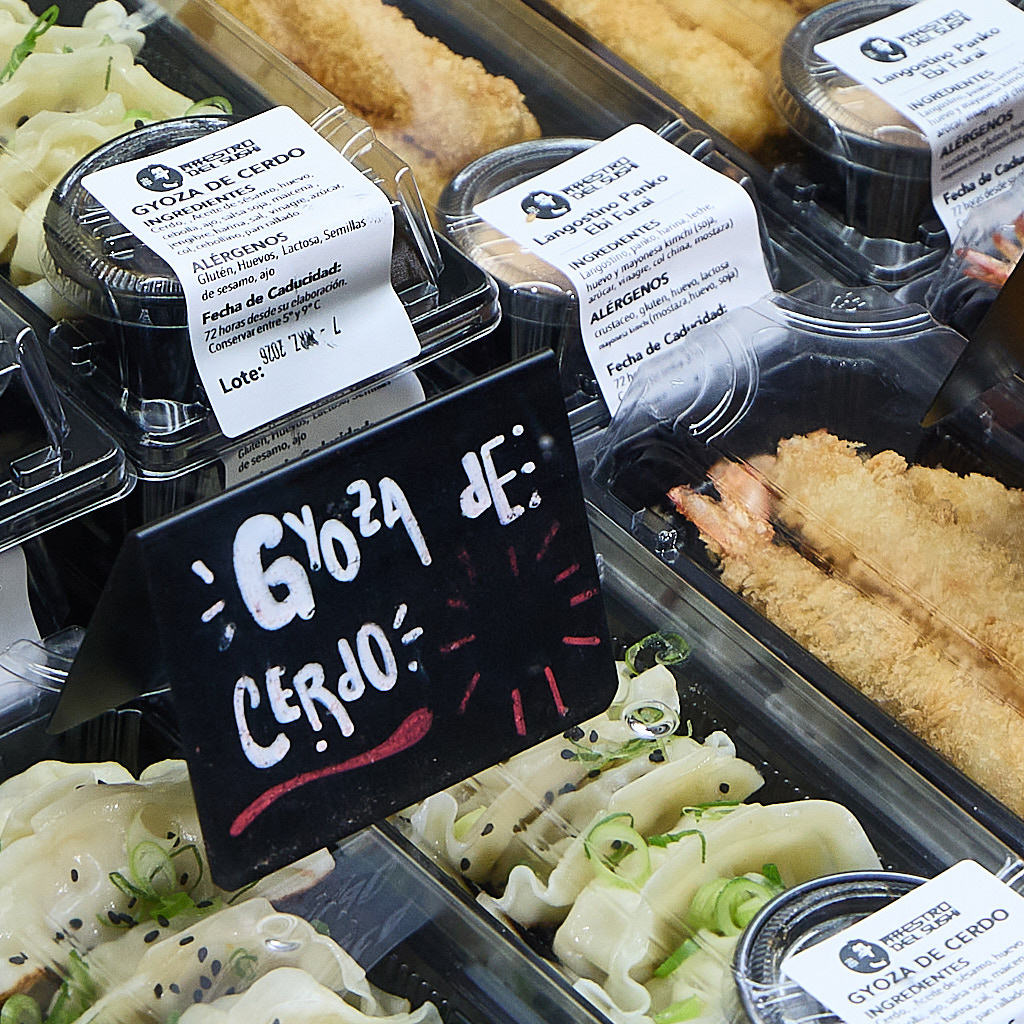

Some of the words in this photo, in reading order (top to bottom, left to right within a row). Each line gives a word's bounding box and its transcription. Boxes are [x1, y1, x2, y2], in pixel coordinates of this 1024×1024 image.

[873, 50, 954, 85] Langostino
[953, 27, 1001, 52] Panko
[921, 64, 949, 80] Ebi
[947, 49, 988, 69] Furai
[907, 68, 995, 111] INGREDIENTES
[940, 109, 1014, 159] ALÉRGENOS
[131, 188, 204, 216] GYOZA
[204, 175, 236, 192] DE
[237, 147, 306, 179] CERDO
[185, 160, 220, 177] DEL
[943, 180, 976, 205] Fecha
[978, 171, 992, 186] de
[143, 184, 257, 228] INGREDIENTES
[532, 201, 619, 246] Langostino
[618, 174, 669, 202] Panko
[571, 184, 603, 201] DEL
[584, 217, 614, 236] Ebi
[611, 195, 655, 221] Furai
[192, 232, 289, 274] ALÉRGENOS
[197, 265, 238, 286] Glutén,
[236, 251, 280, 272] Huevos,
[281, 235, 323, 256] Lactosa,
[323, 218, 367, 241] Semillas
[568, 218, 662, 271] INGREDIENTES
[201, 289, 215, 302] de
[217, 275, 259, 296] sesamo,
[259, 267, 276, 282] ajo
[201, 302, 243, 326] Fecha
[245, 293, 264, 308] de
[267, 261, 343, 300] Caducidad:
[589, 271, 670, 325] ALÉRGENOS
[718, 267, 740, 285] soja)
[203, 328, 218, 342] 72
[218, 320, 246, 337] horas
[246, 305, 277, 325] desde
[277, 301, 290, 314] su
[290, 277, 348, 309] elaboración.
[594, 311, 639, 338] crustaceo,
[639, 293, 671, 316] gluten,
[669, 277, 700, 298] huevo,
[699, 260, 730, 282] lactosa
[208, 328, 256, 355] Conservar
[256, 318, 282, 335] entre
[293, 309, 302, 322] y
[218, 366, 265, 394] Lote:
[606, 351, 644, 377] Fecha
[644, 340, 662, 355] de
[238, 460, 250, 474] de
[250, 441, 291, 466] sesamo,
[291, 431, 307, 447] ajo
[233, 477, 432, 631] GYOZA
[847, 966, 917, 1005] GYOZA
[914, 947, 946, 969] DE
[944, 908, 1009, 950] CERDO
[890, 934, 921, 952] DEL
[864, 957, 970, 1019] INGREDIENTES
